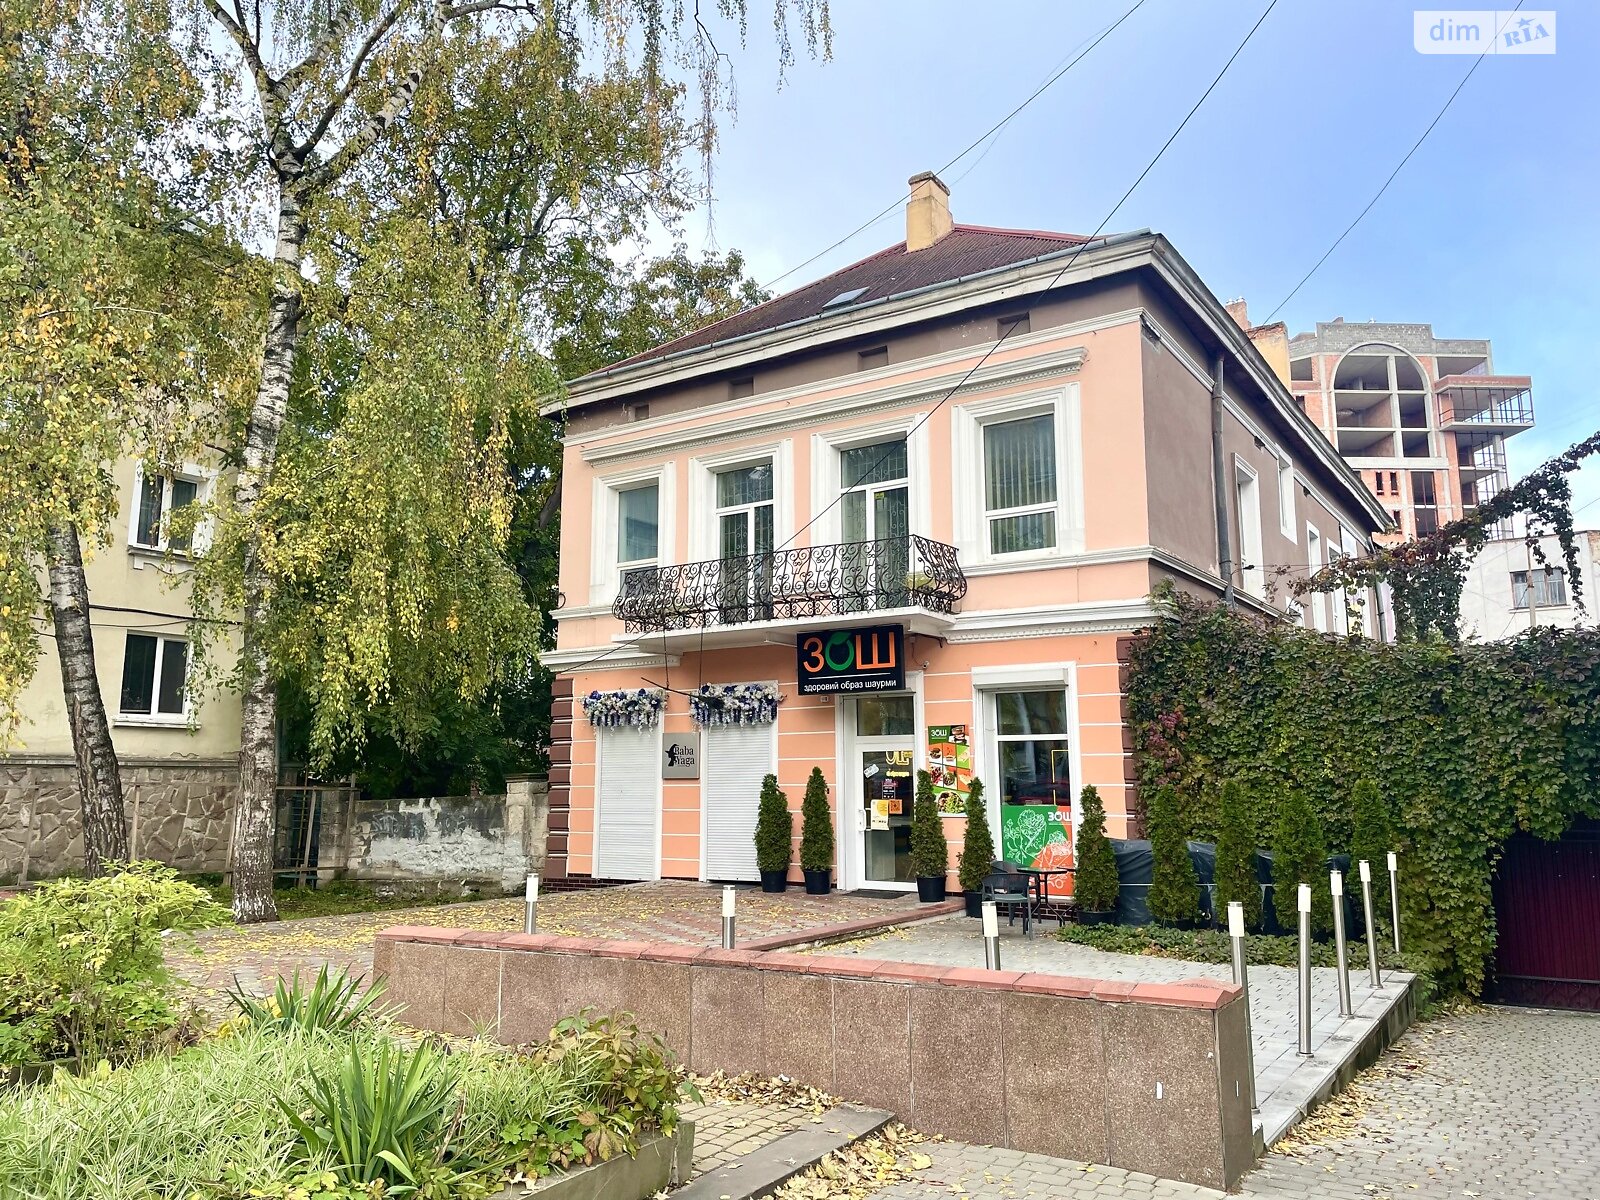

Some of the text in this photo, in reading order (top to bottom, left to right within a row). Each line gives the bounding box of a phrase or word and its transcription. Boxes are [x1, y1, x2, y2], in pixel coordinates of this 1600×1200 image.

[803, 631, 896, 673] ЗОШ
[803, 679, 897, 692] здоровий образ шаурми
[674, 745, 694, 756] Baba
[675, 756, 695, 767] Yaga
